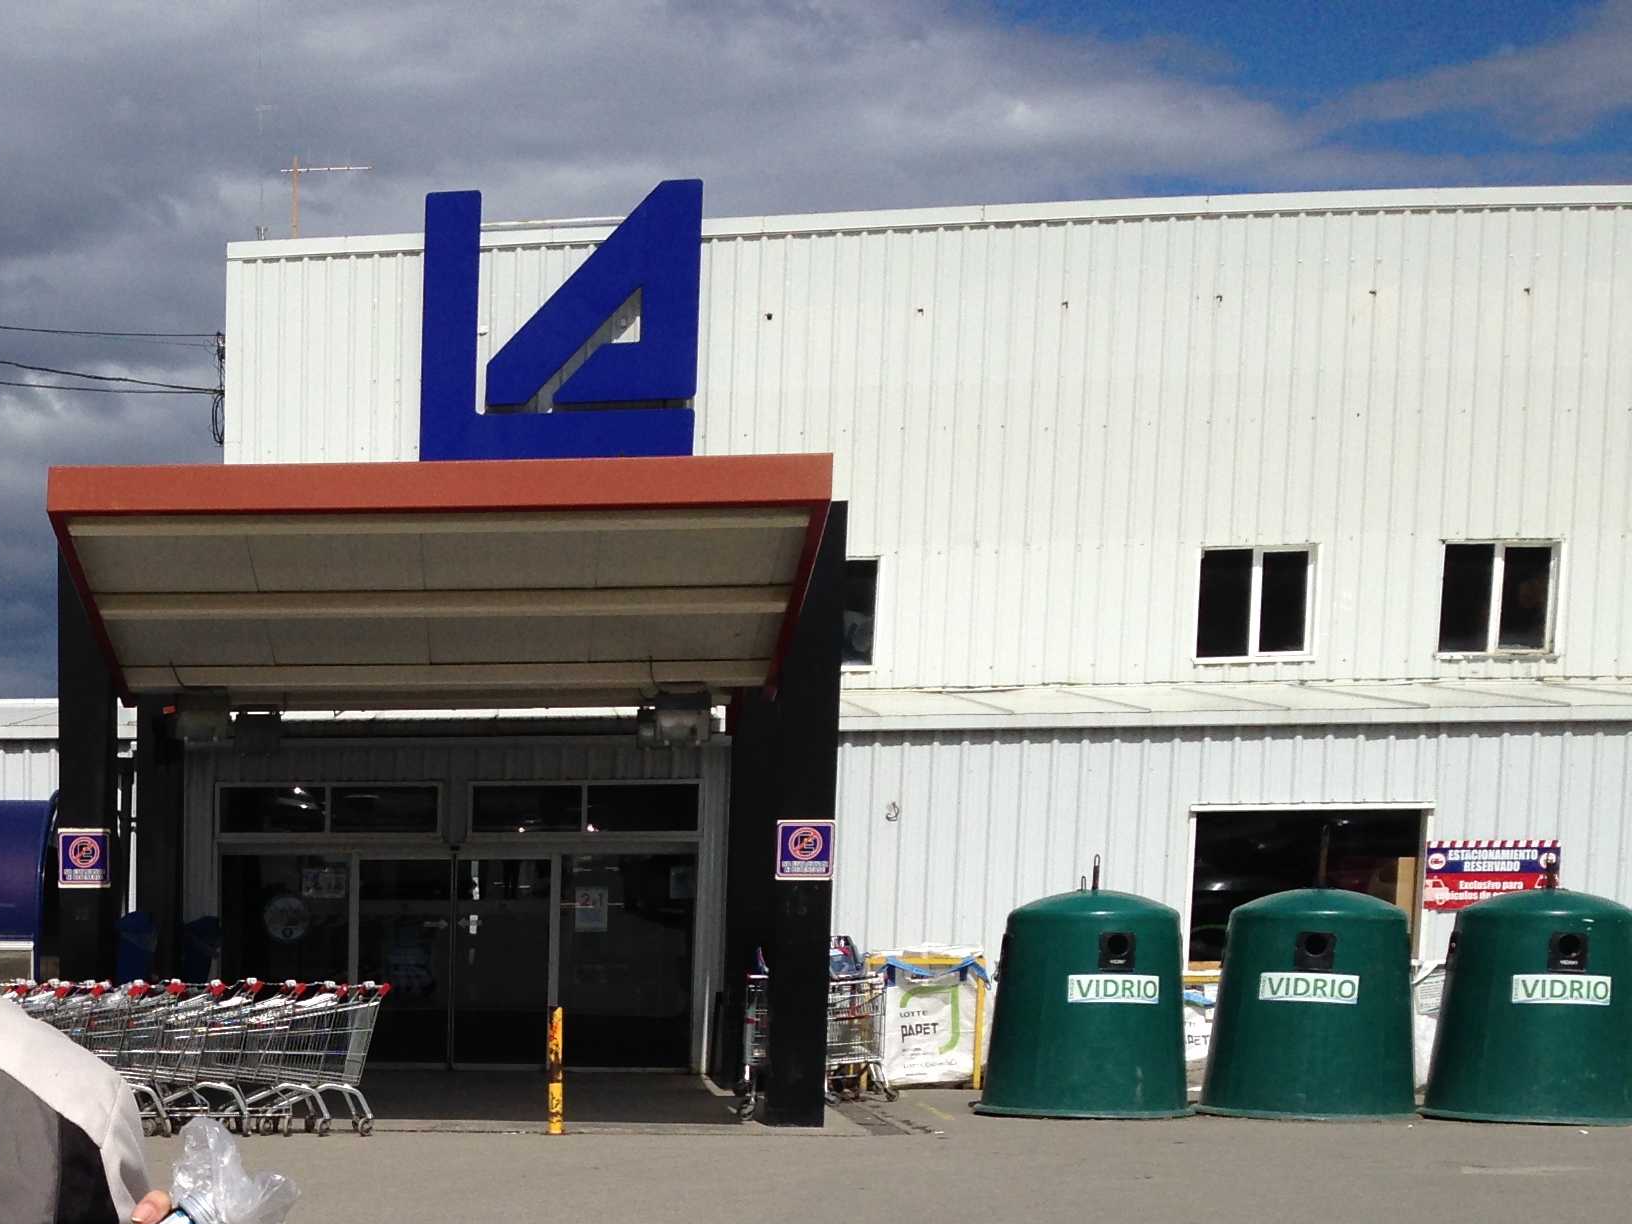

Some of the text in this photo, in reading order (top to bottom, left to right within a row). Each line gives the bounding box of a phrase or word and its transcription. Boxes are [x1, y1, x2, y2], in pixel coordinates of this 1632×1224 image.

[1447, 849, 1539, 861] ESTACIONAMIENTO
[1463, 861, 1521, 872] RESERVADO
[1459, 880, 1524, 891] Exclusivo para
[1076, 979, 1158, 998] VIDRIO
[1267, 977, 1357, 999] VIDRIO
[1520, 979, 1609, 1001] VIDRIO
[899, 1010, 929, 1018] LOTTE
